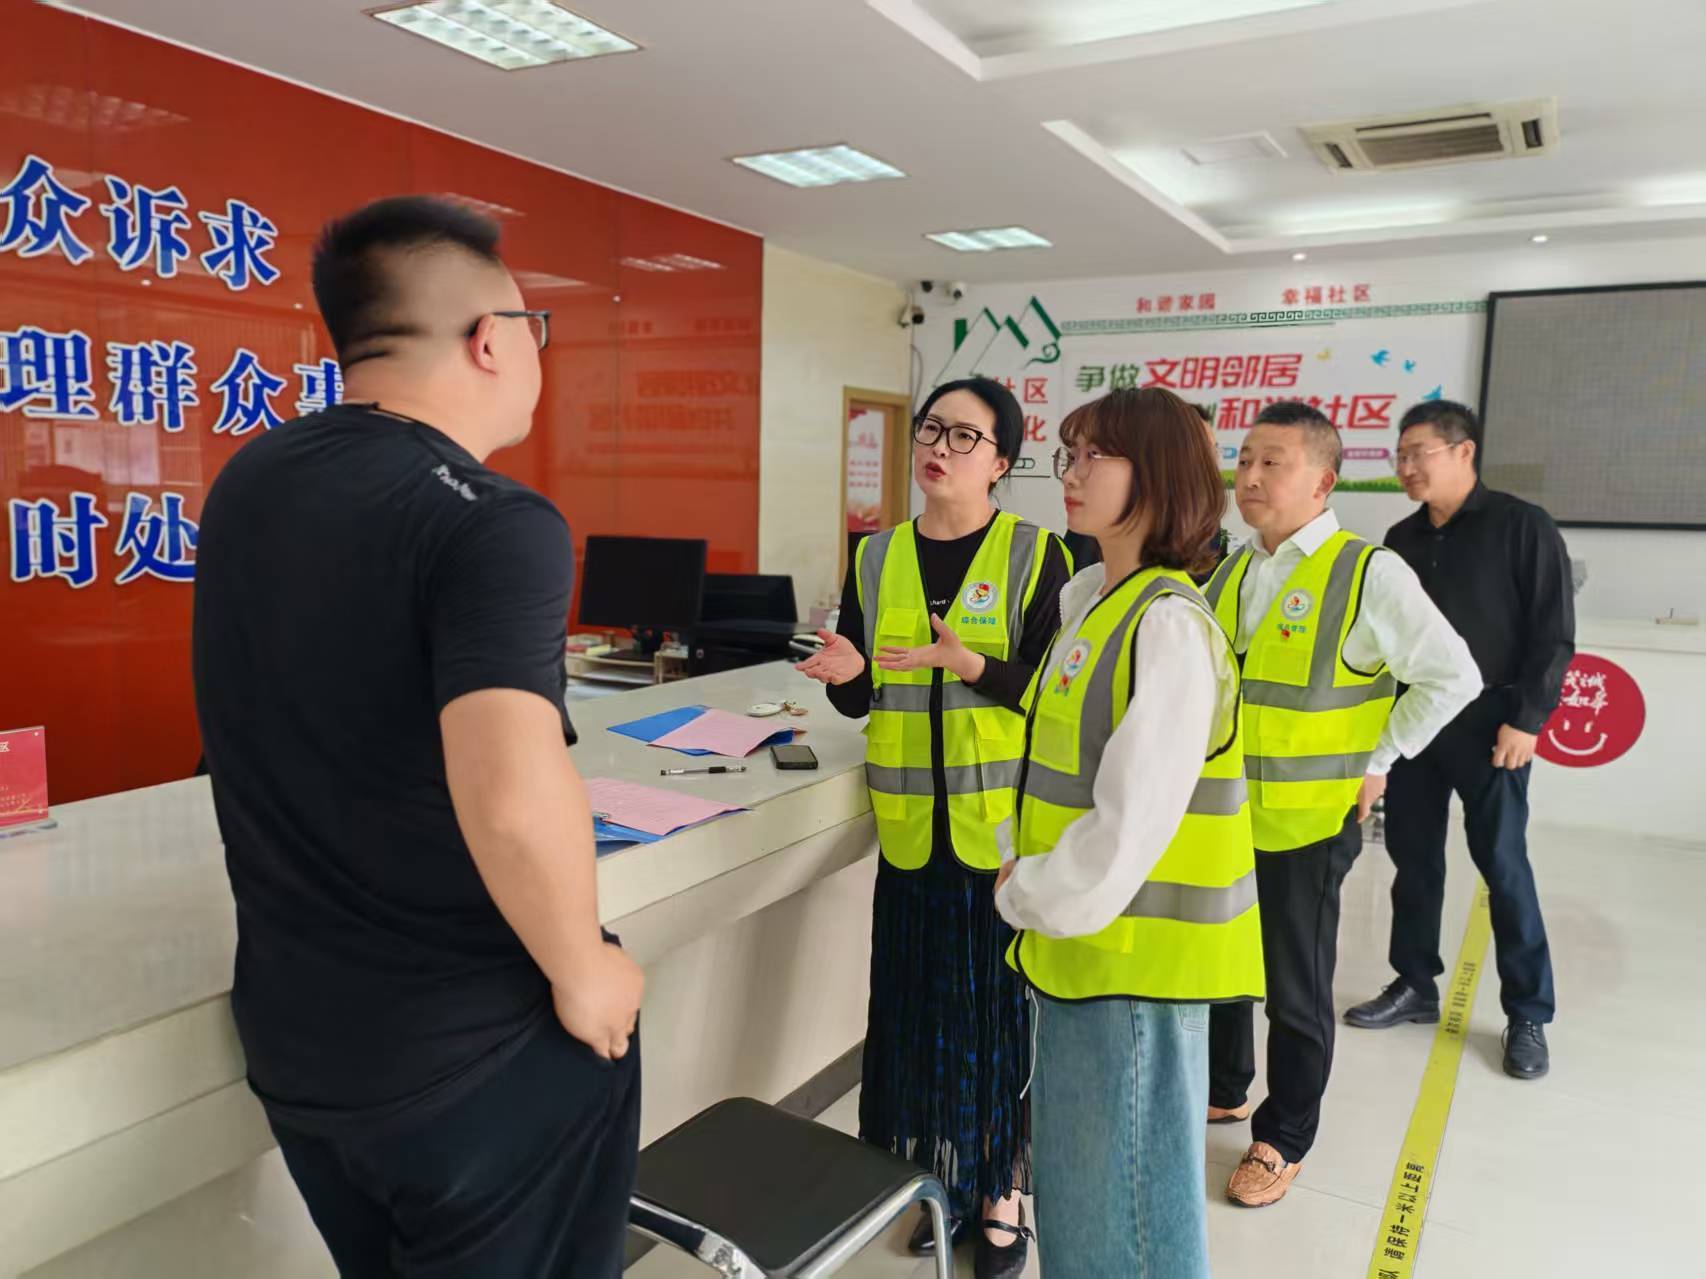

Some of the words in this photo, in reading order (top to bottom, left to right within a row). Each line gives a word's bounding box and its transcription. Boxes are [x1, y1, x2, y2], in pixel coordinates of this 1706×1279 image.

[0, 154, 280, 290] 众诉求
[1281, 284, 1371, 305] 幸福社区
[1075, 353, 1303, 392] 争做文明邻居
[9, 491, 199, 588] 时处
